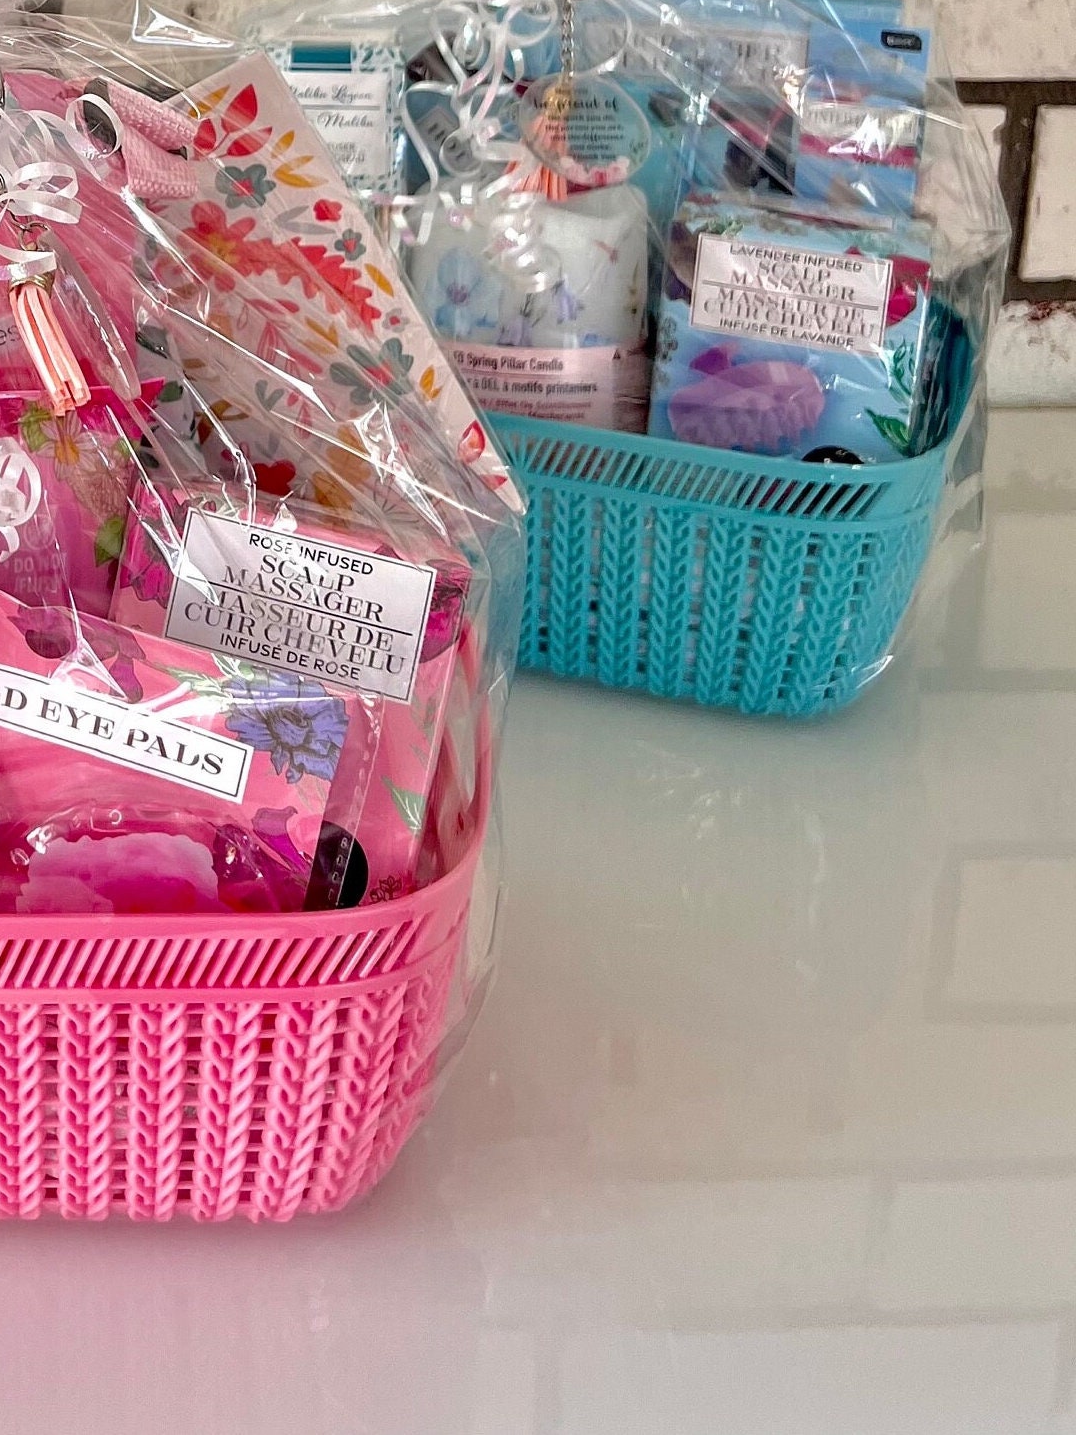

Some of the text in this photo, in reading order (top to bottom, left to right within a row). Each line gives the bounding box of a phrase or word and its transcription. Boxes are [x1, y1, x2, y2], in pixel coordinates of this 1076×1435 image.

[730, 244, 863, 273] LAVENDER INFUSED
[759, 260, 831, 282] SCALP
[730, 269, 856, 302] MASSAGER
[703, 299, 875, 338] CUIR CHEVELU
[717, 287, 865, 322] MASSEUR DE
[769, 325, 790, 338] DE
[791, 329, 855, 347] LAVANDE
[466, 352, 498, 370] Spring
[500, 355, 527, 371] Pillar
[529, 357, 564, 372] Candle
[511, 380, 543, 393] motifs
[260, 554, 355, 592] SCALP
[299, 545, 374, 575] INFUSED
[222, 565, 384, 623] MASSAGER
[184, 602, 407, 675] CUIR CHEVELU
[349, 626, 394, 653] DE
[220, 633, 361, 681] INFUSÉ DE ROSE
[37, 696, 116, 741] EYE
[125, 727, 225, 777] PALS
